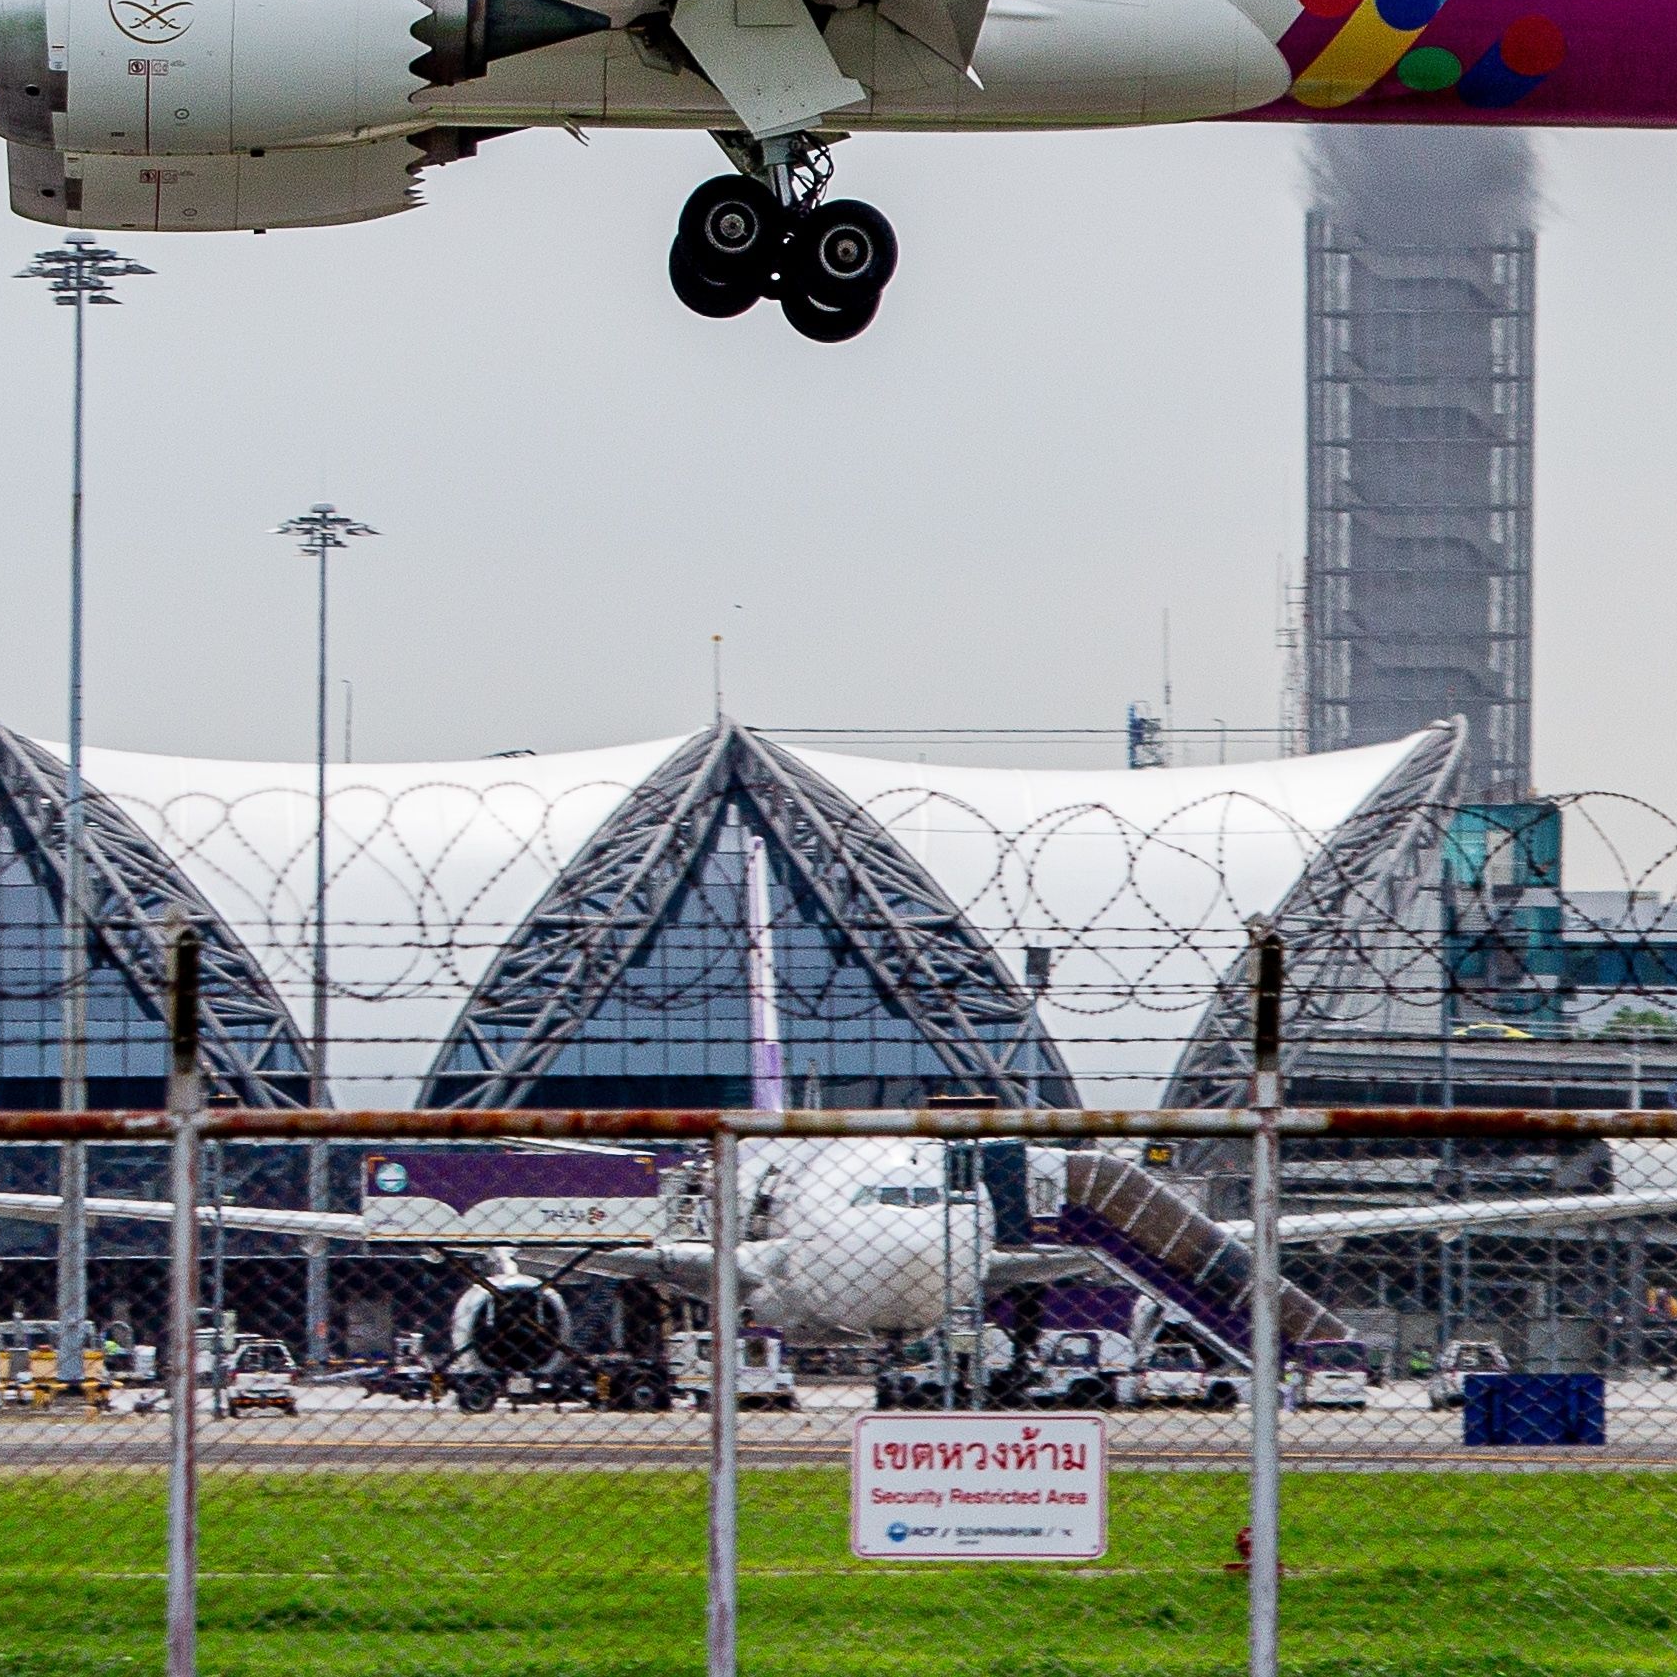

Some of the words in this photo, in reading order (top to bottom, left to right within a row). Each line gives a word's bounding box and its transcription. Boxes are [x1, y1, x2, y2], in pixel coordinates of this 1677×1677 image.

[873, 1425, 1087, 1471] เขตหวงห้าม
[871, 1487, 943, 1508] Security
[949, 1487, 1041, 1505] Restricted
[1046, 1488, 1088, 1505] Area
